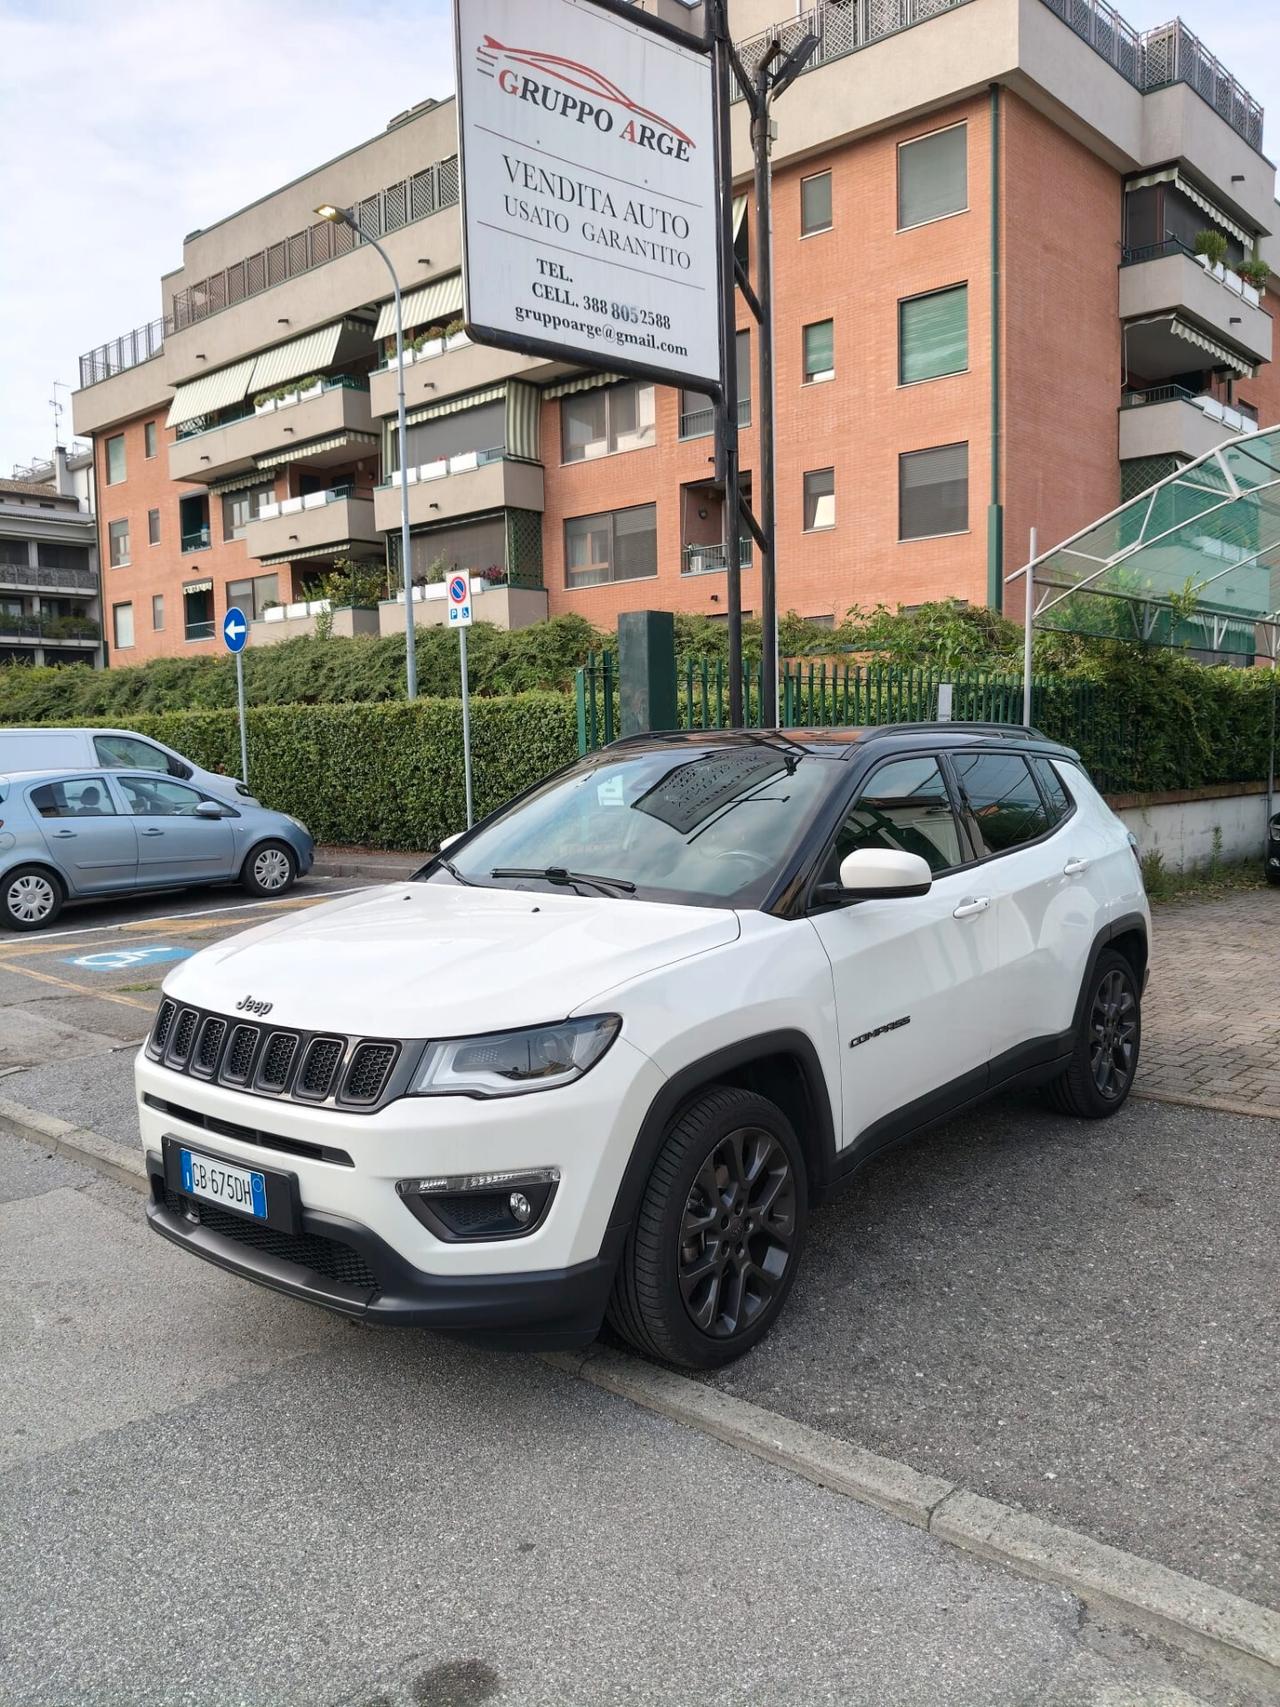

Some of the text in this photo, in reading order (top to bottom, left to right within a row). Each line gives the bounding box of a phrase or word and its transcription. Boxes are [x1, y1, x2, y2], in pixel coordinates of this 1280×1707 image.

[499, 69, 690, 162] GRUPPO ARGE
[502, 154, 690, 239] VENDITA AUTO
[504, 195, 691, 270] USATO GARANTITO
[531, 282, 579, 308] CELL.
[536, 258, 573, 283] TEL.
[515, 305, 688, 357] gruppoarge@gmail.com
[235, 995, 273, 1017] Jeep
